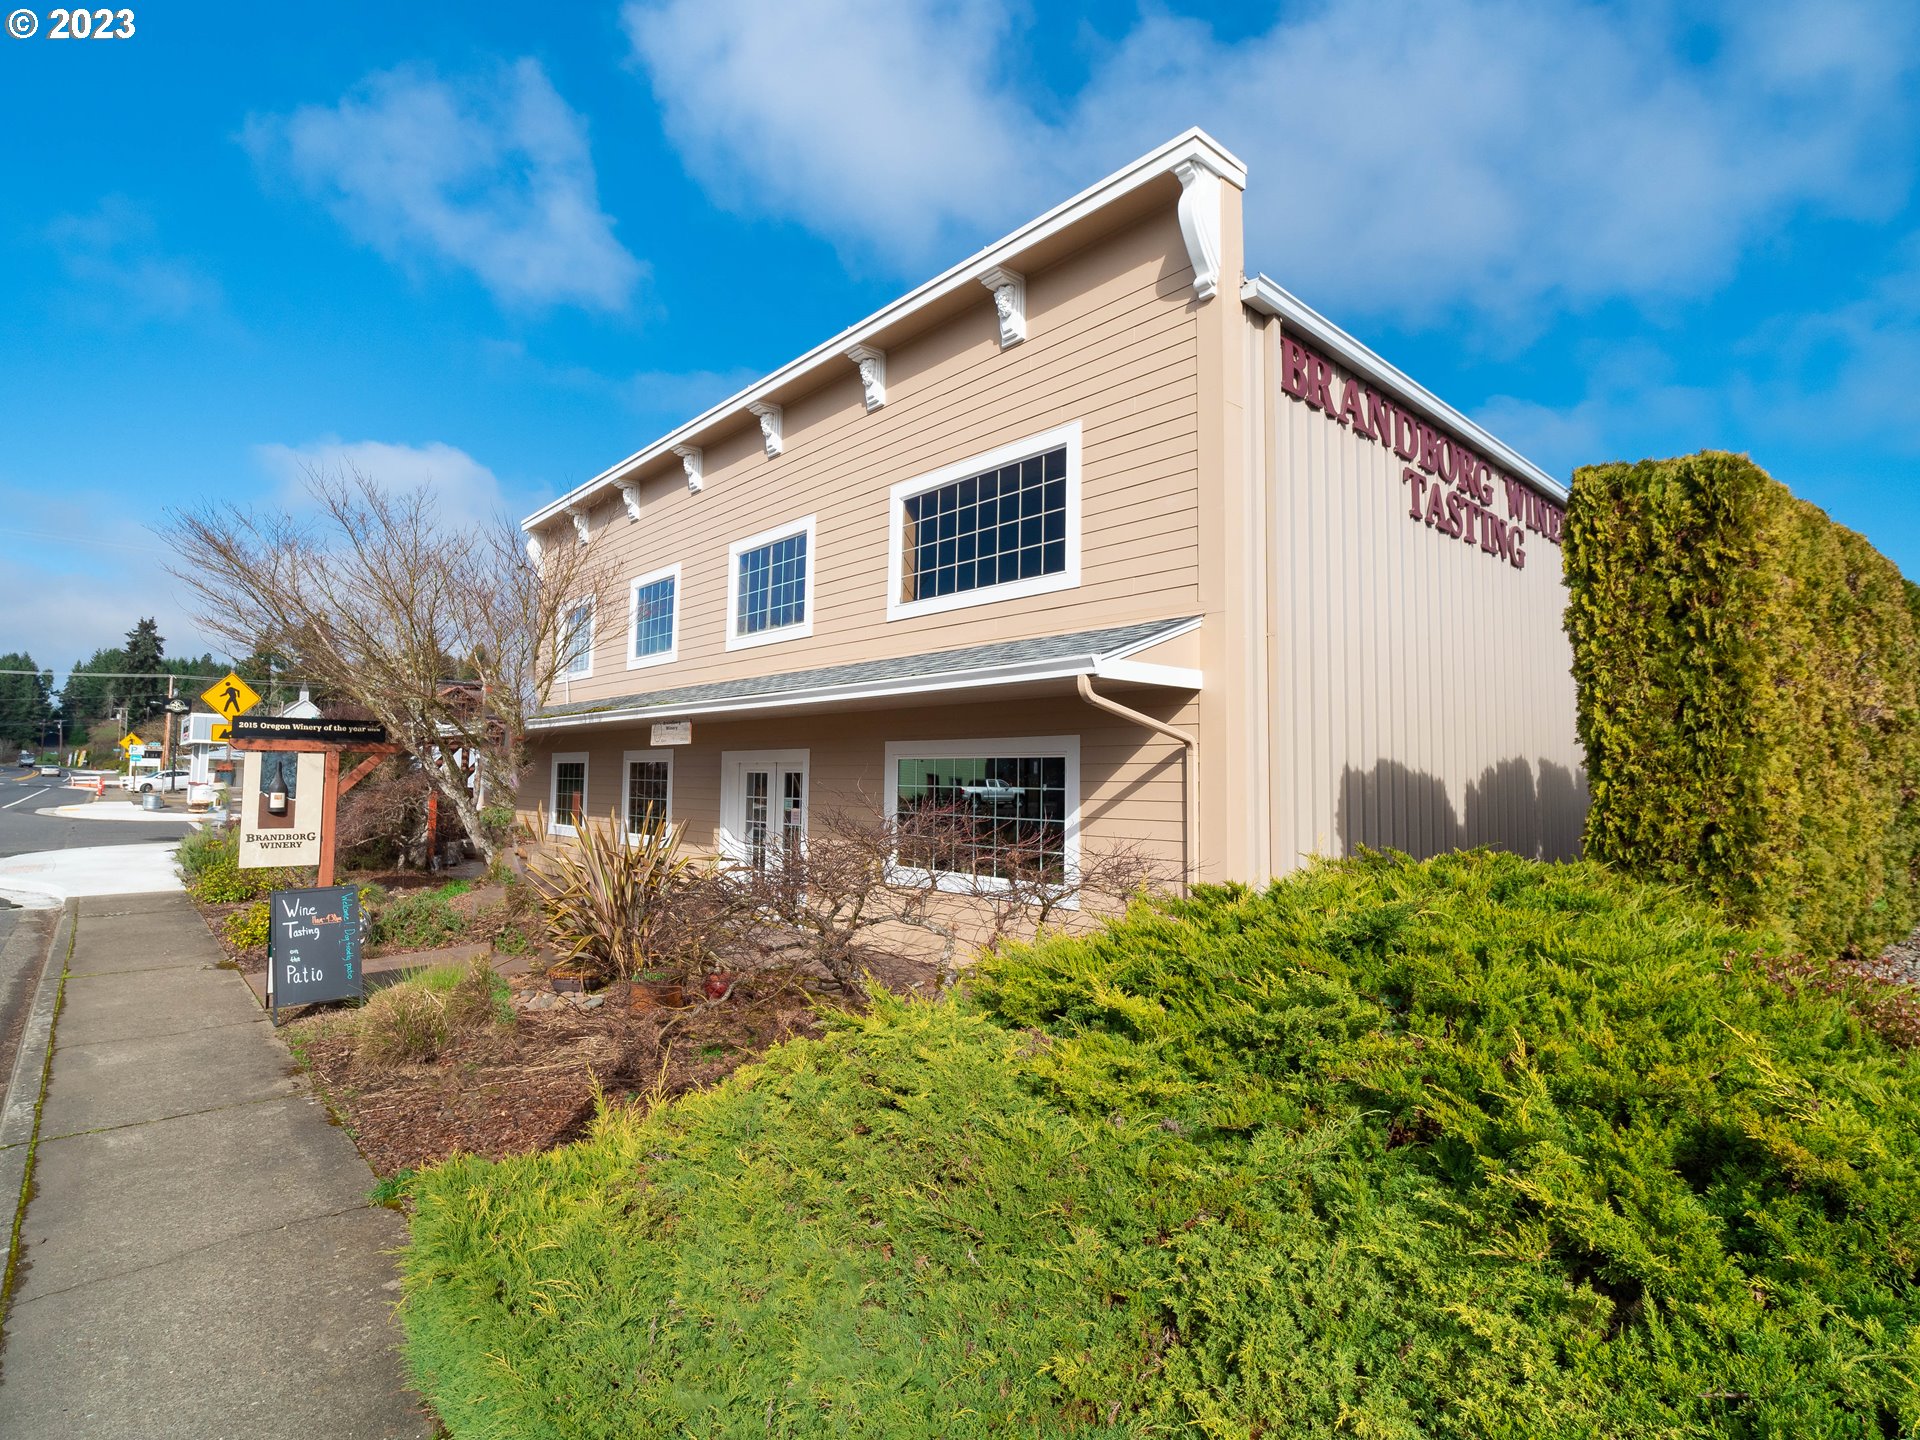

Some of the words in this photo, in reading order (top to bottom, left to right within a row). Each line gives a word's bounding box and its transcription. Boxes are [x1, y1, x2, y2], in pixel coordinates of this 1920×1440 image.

[1280, 335, 1494, 507] BRANDBORG
[1403, 467, 1526, 569] TASTING
[238, 721, 258, 729] 2015
[260, 722, 291, 731] Oregon
[292, 723, 322, 732] Winery
[323, 724, 333, 732] of
[246, 832, 317, 843] BRANDBORG
[260, 841, 303, 849] WINERY
[282, 898, 318, 918] Wine
[282, 920, 320, 940] Tasting
[286, 964, 323, 984] Patio
